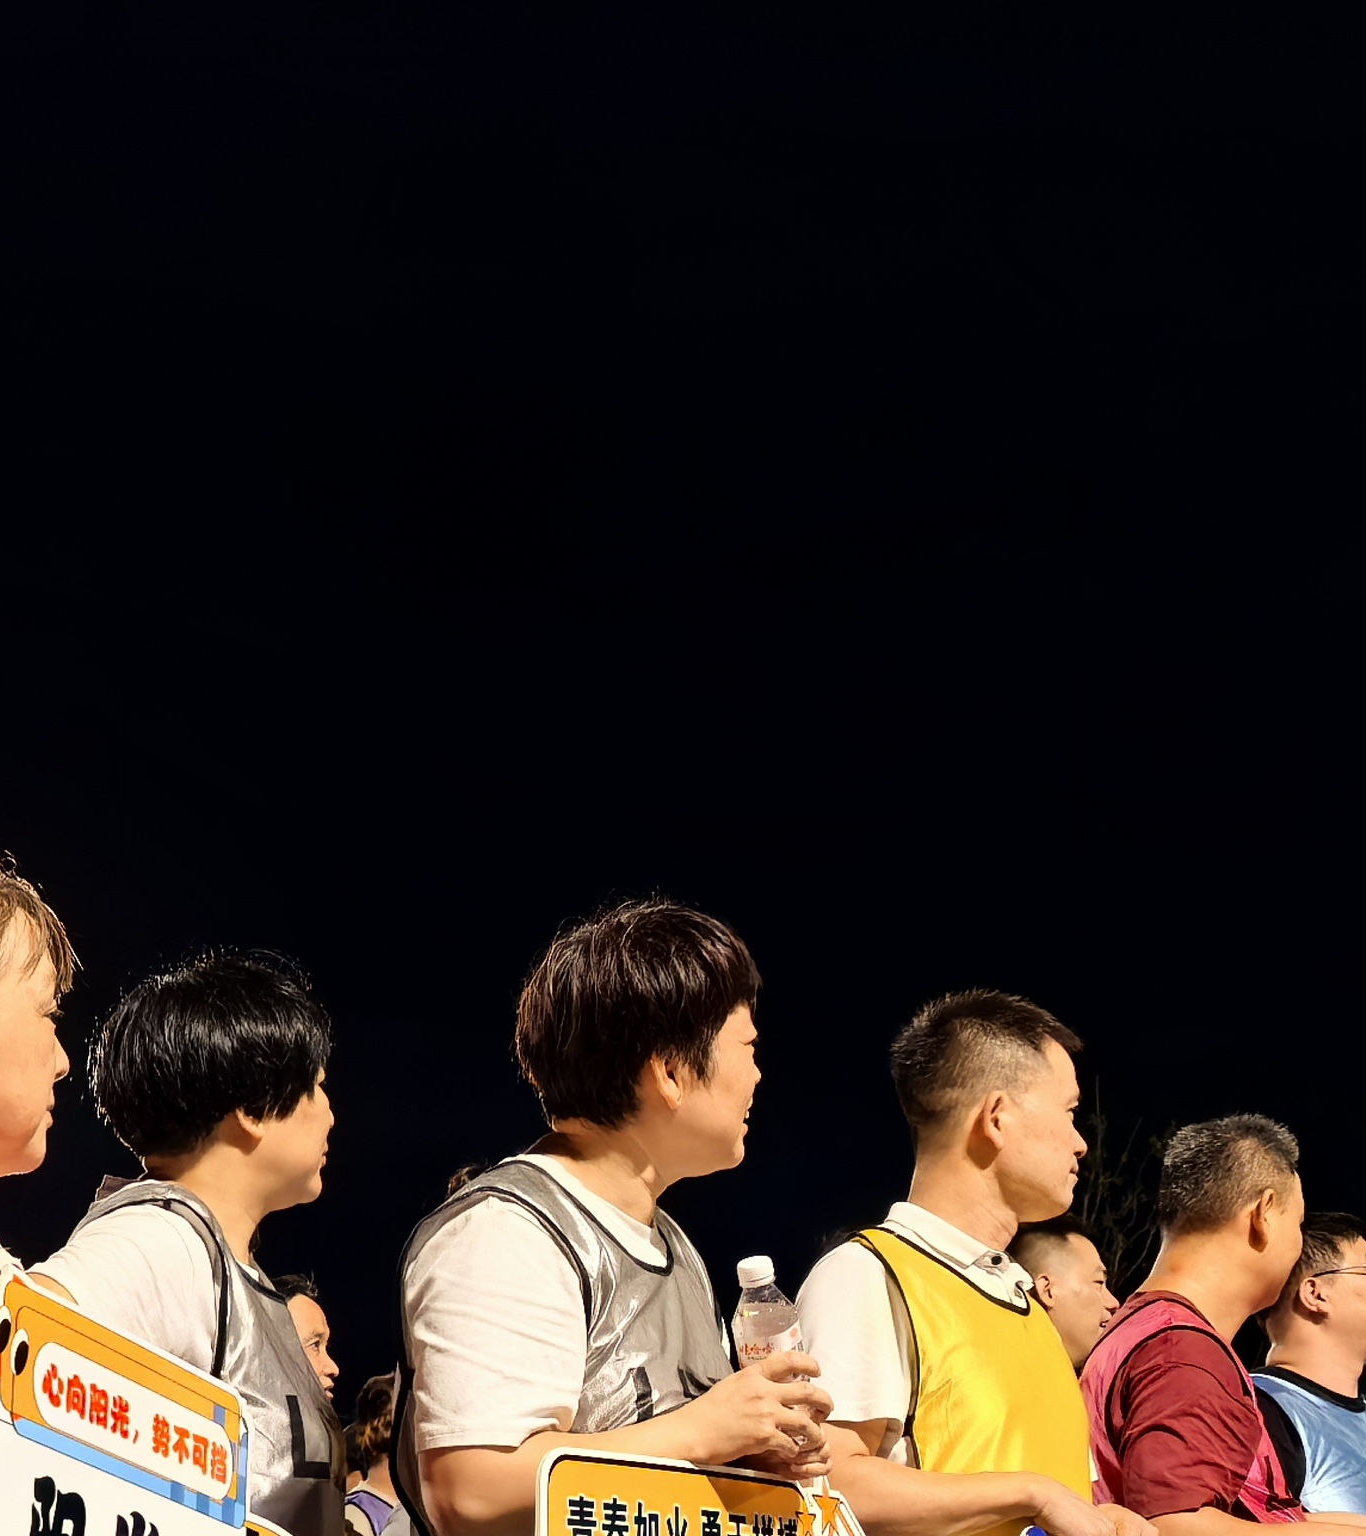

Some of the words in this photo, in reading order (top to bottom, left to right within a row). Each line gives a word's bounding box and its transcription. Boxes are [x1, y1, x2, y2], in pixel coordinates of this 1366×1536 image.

[41, 1361, 229, 1485] 心向阳光，势不可挡
